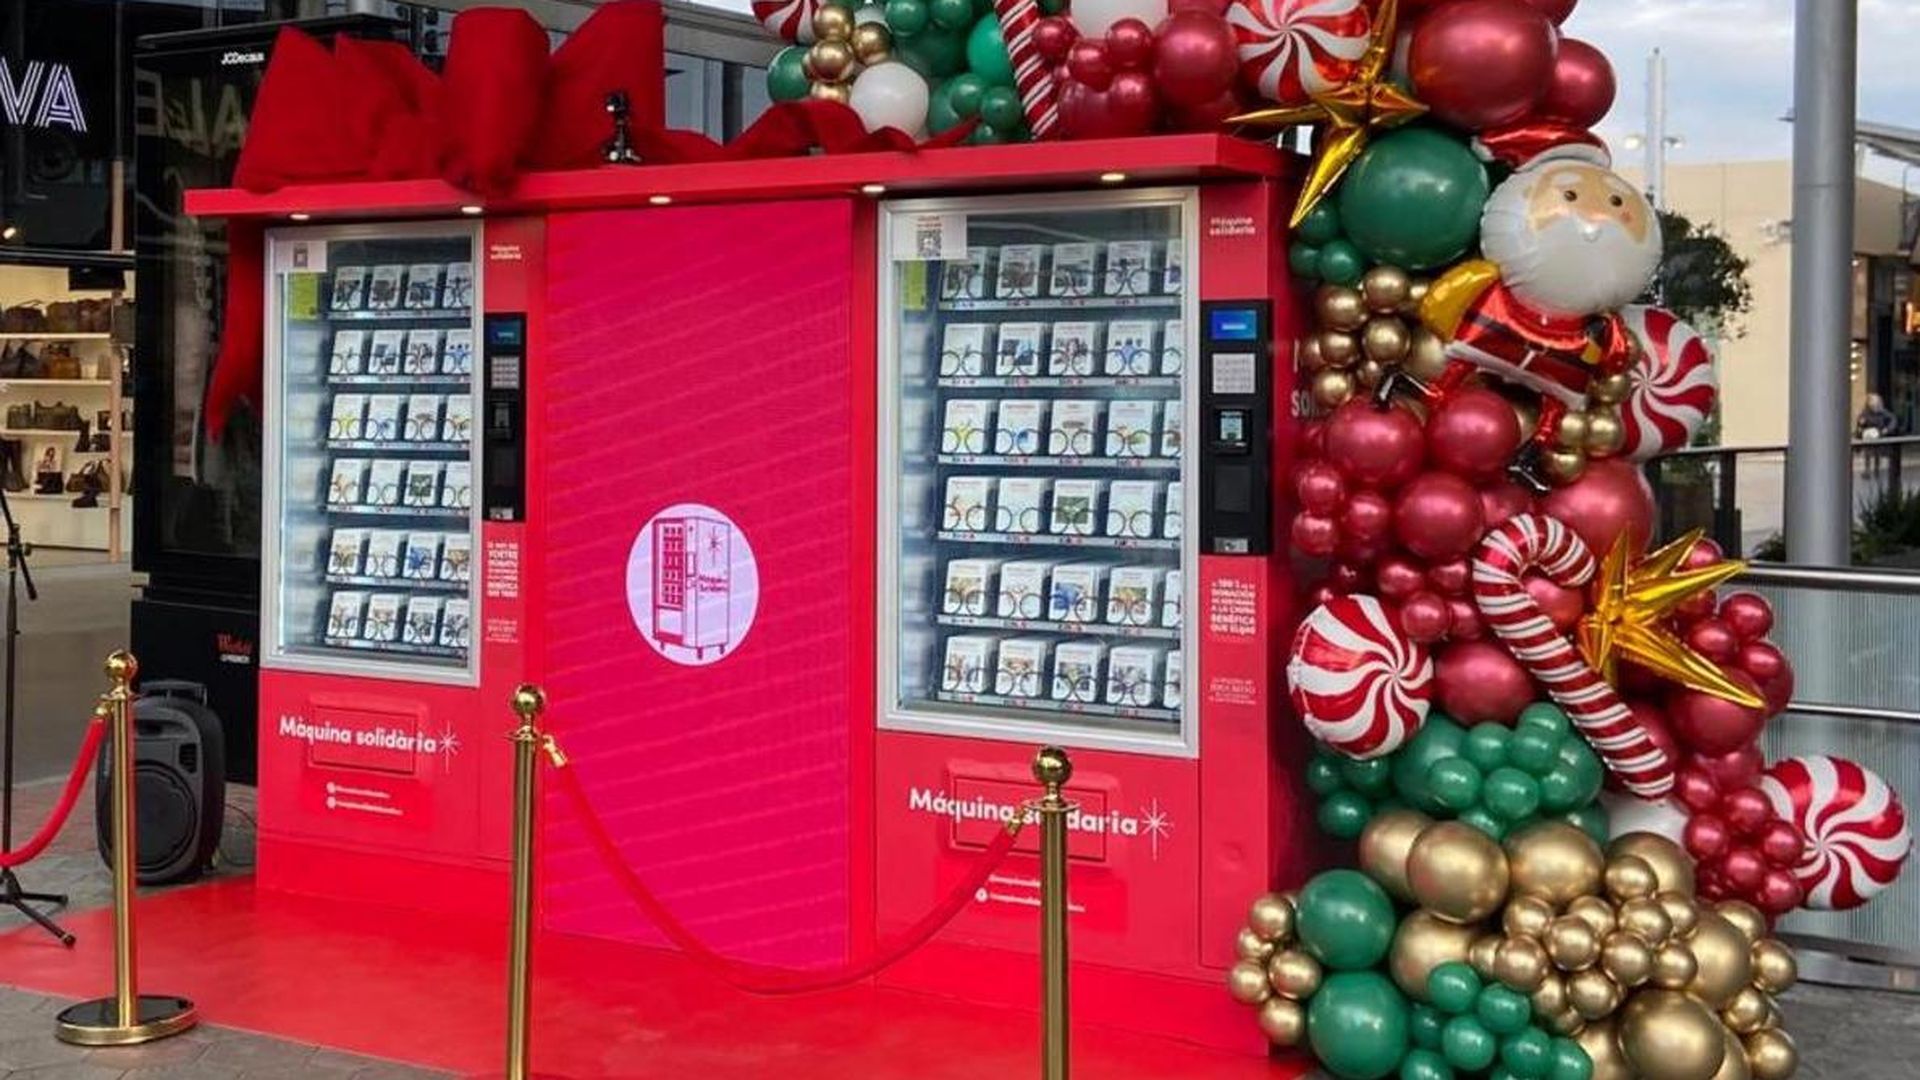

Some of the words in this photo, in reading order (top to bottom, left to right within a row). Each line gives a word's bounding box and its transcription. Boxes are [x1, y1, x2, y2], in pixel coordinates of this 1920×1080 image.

[221, 51, 265, 65] JCDecaux
[909, 787, 1016, 824] Máquina
[1021, 806, 1139, 836] sdaria
